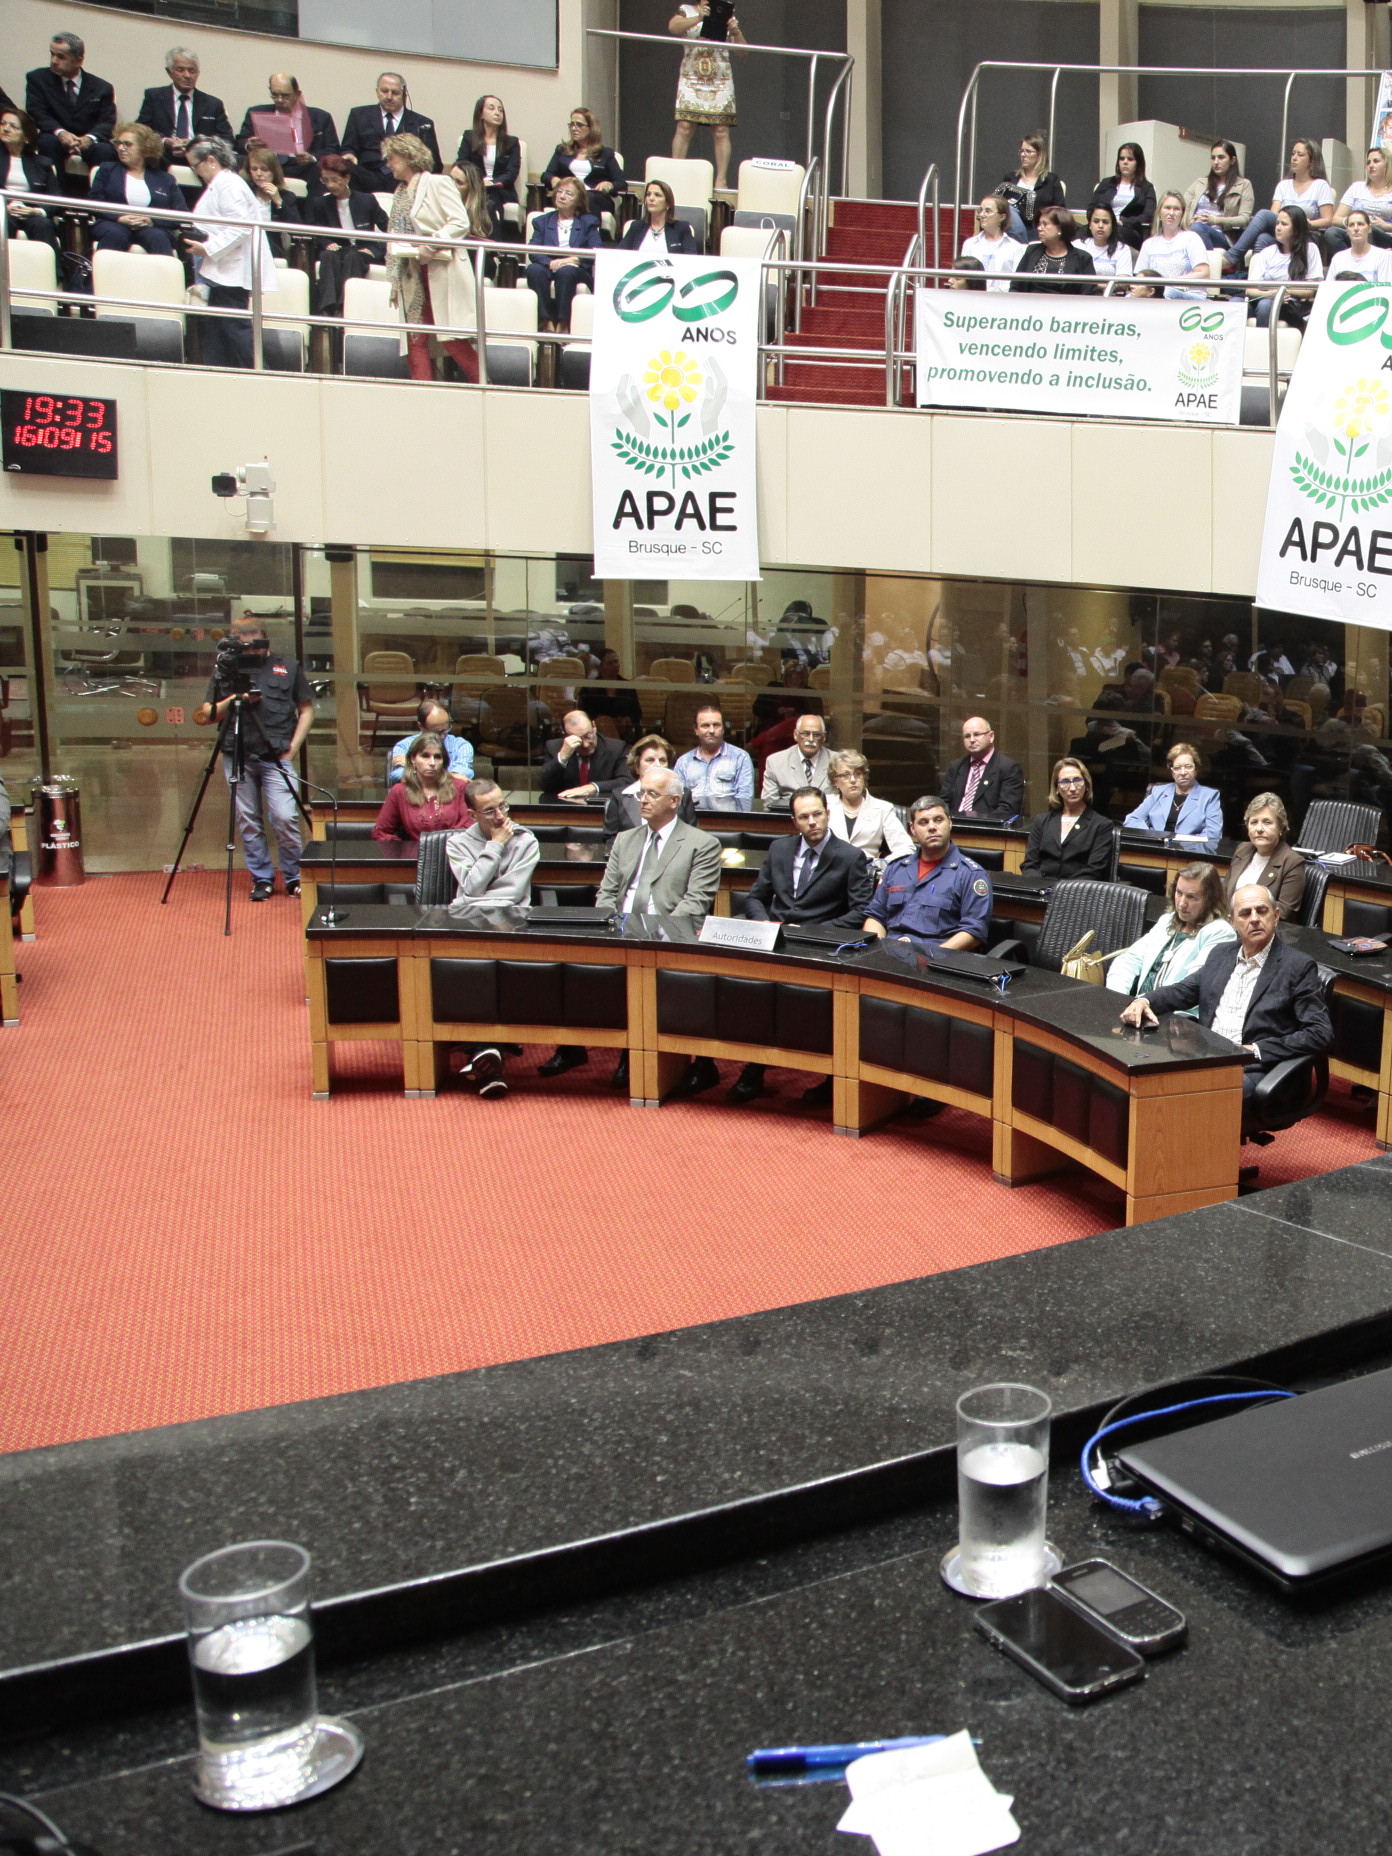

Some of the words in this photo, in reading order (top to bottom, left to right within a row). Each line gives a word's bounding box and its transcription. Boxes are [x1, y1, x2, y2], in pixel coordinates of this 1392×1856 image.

[755, 160, 791, 168] CORAL
[942, 310, 1044, 333] Superando
[1049, 315, 1143, 339] barreiras,
[681, 326, 738, 345] ANOS
[1203, 333, 1224, 341] ANOS
[958, 341, 1048, 360] vencendo
[1052, 343, 1124, 367] limites,
[926, 365, 1043, 387] promovendo
[1048, 373, 1061, 387] a
[1065, 370, 1152, 392] inclusão.
[1174, 392, 1219, 409] APAE
[24, 396, 106, 429] 19:33
[612, 489, 738, 532] APAE
[628, 540, 688, 557] Brusque
[701, 541, 724, 555] SC
[1289, 570, 1343, 594] Brusque
[1355, 581, 1378, 599] SC
[41, 840, 80, 850] PLÁSTICO
[712, 931, 763, 945] Autoridades
